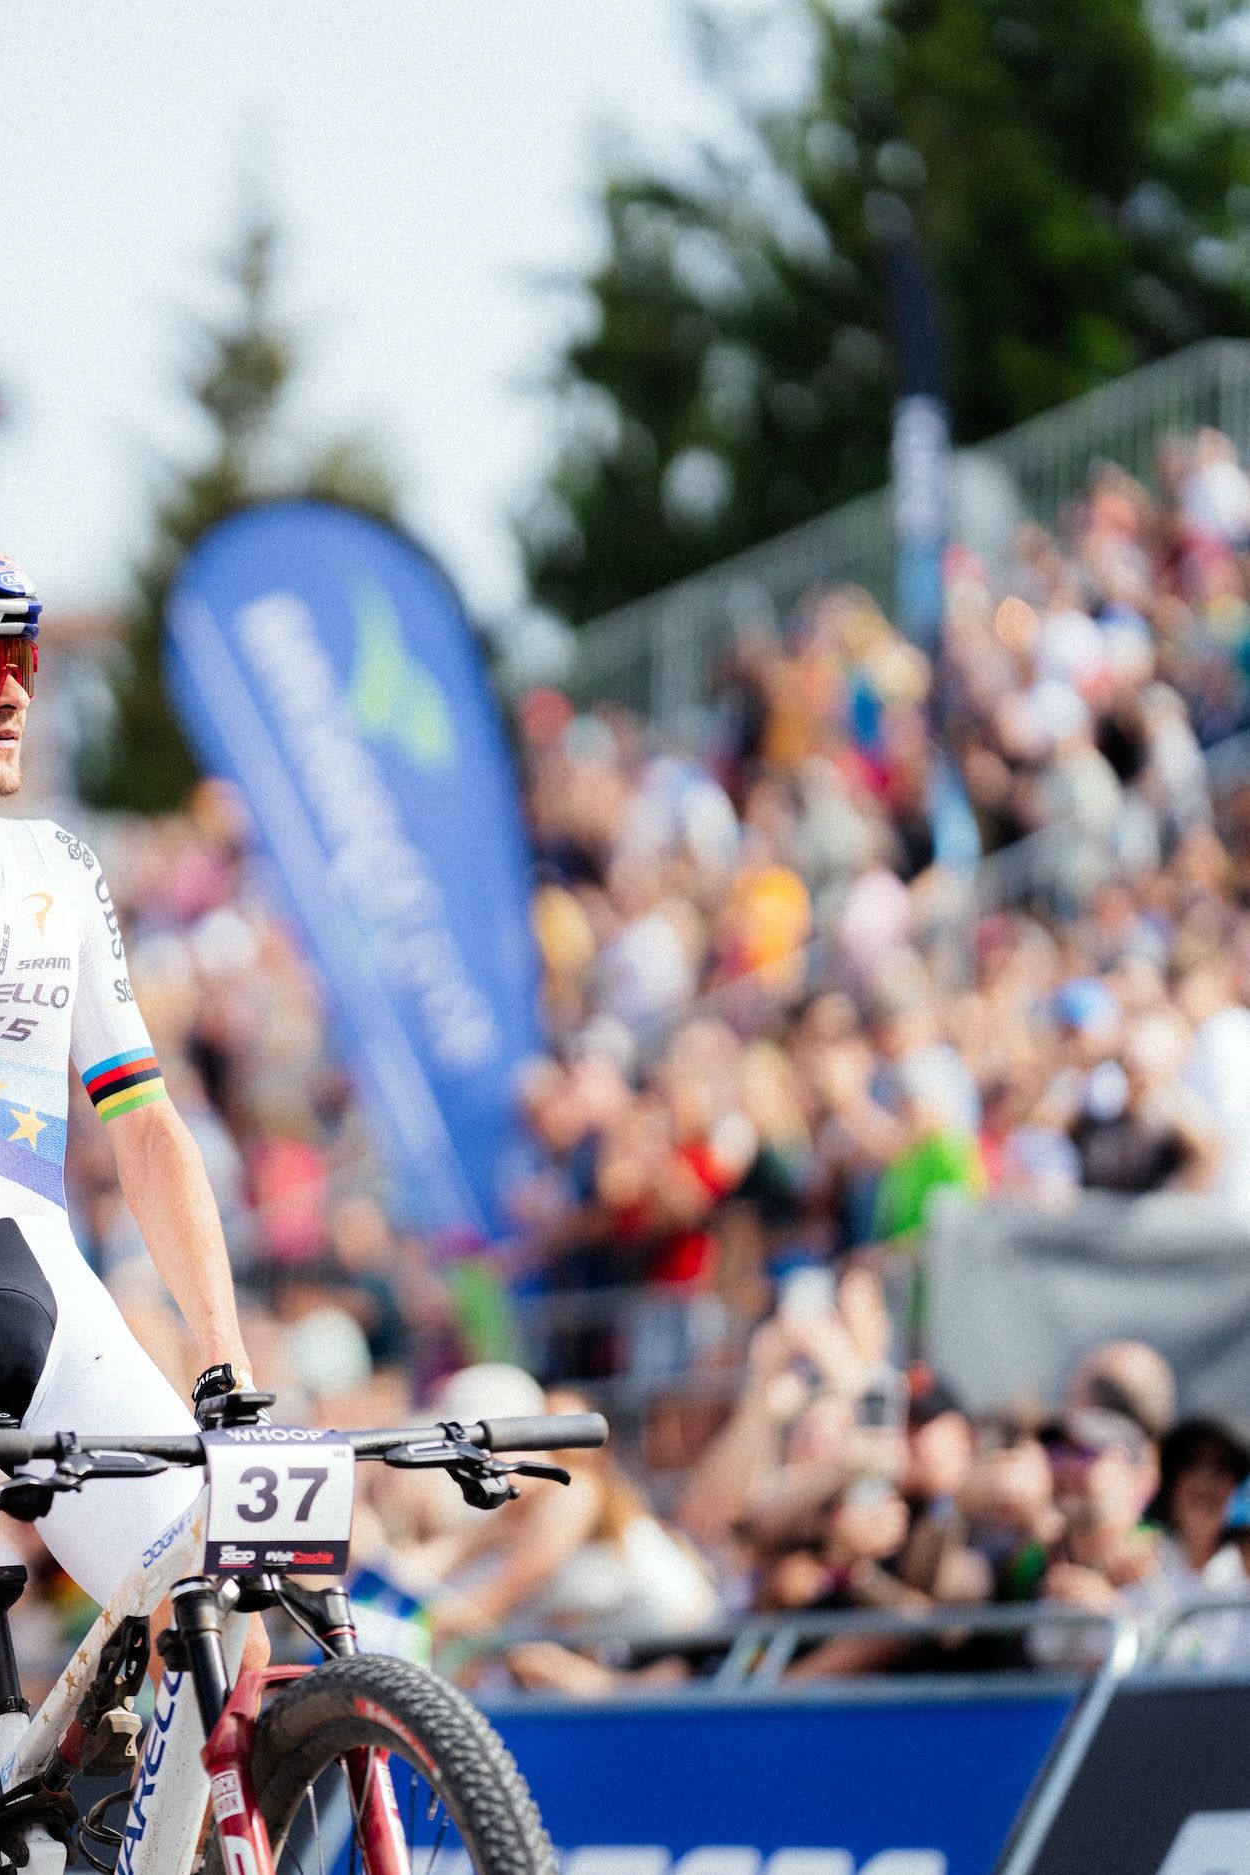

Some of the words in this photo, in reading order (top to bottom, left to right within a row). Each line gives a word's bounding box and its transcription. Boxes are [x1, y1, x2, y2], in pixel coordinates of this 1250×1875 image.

[16, 957, 72, 971] SRAM
[225, 1428, 325, 1442] WHOOP
[236, 1466, 329, 1524] 37
